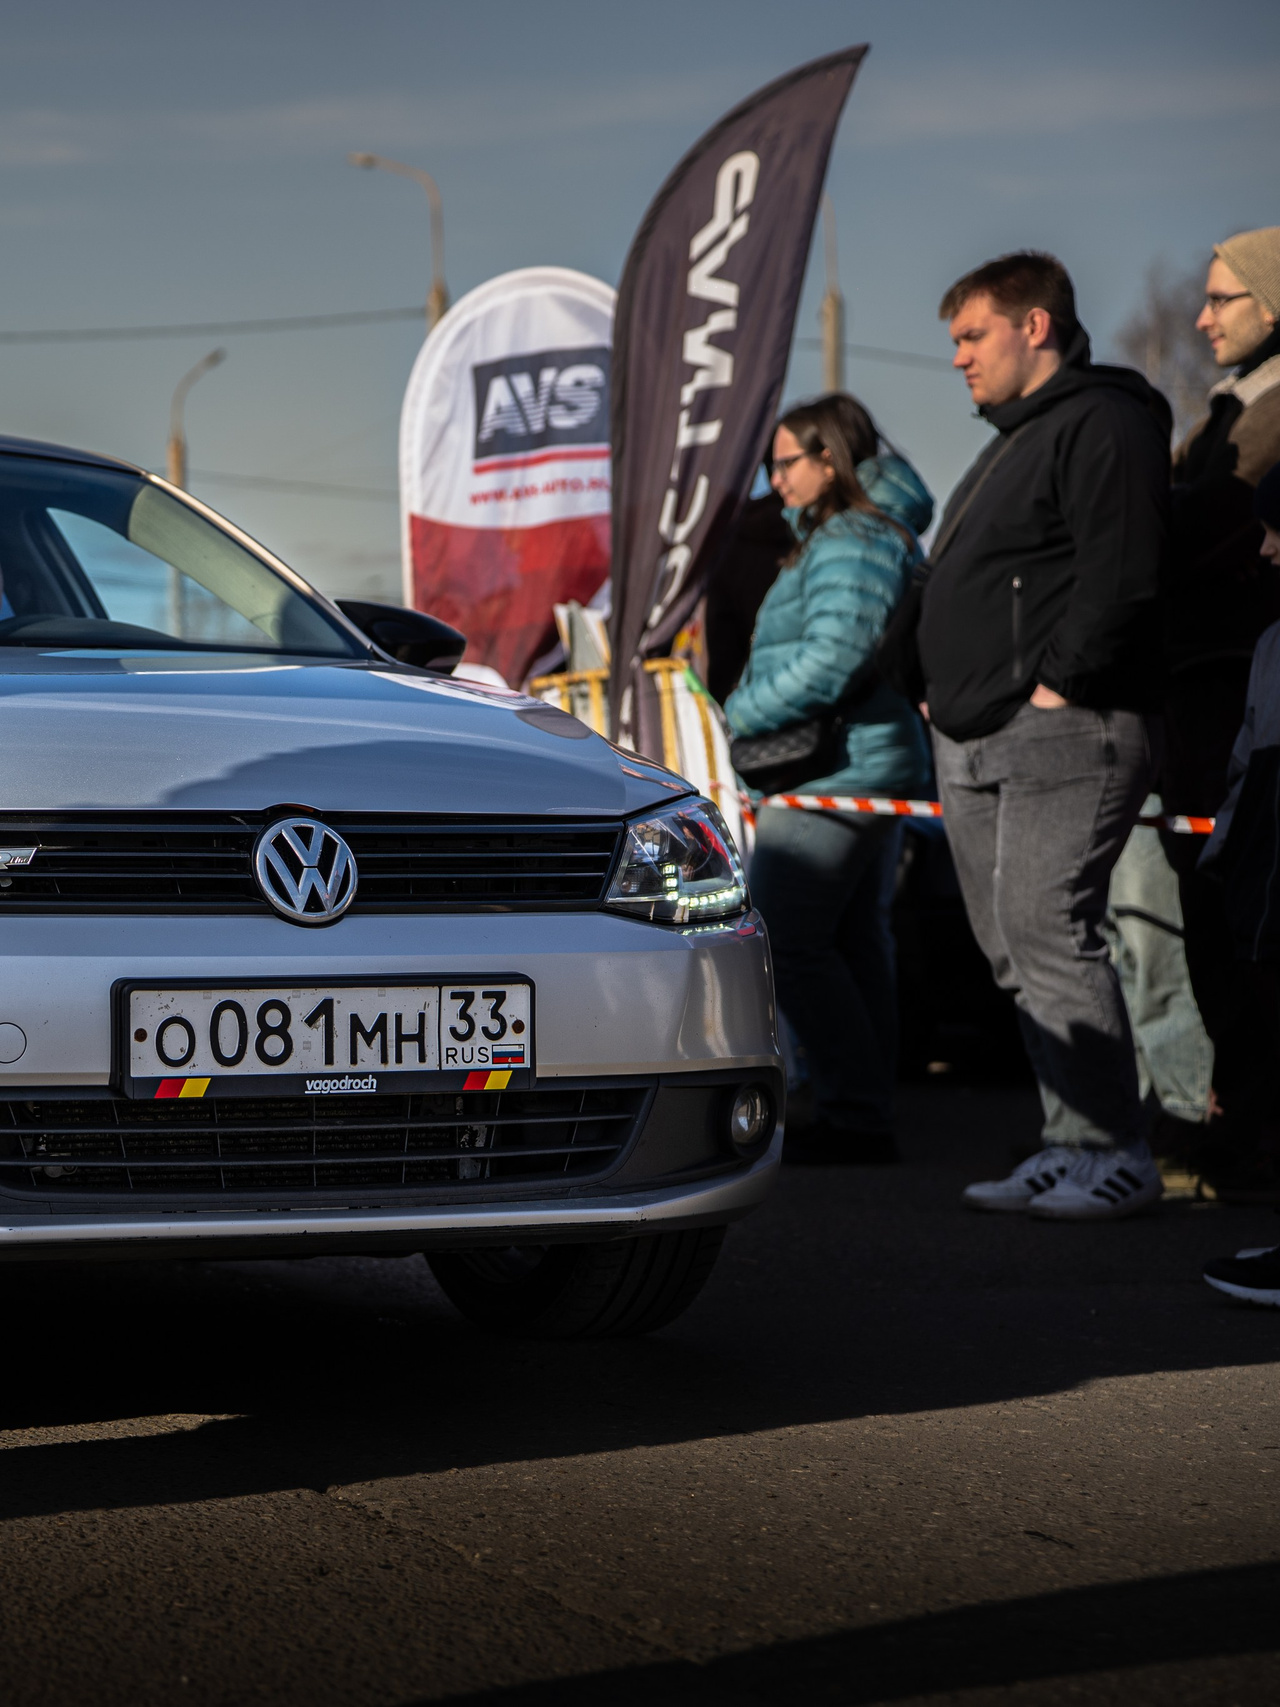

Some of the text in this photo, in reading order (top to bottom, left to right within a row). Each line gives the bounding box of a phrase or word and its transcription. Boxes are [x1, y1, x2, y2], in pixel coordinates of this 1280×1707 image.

[477, 363, 606, 443] AVS
[259, 819, 355, 919] VW
[449, 991, 507, 1042] 33
[446, 1046, 489, 1064] RUS
[305, 1074, 377, 1093] vagodroch
